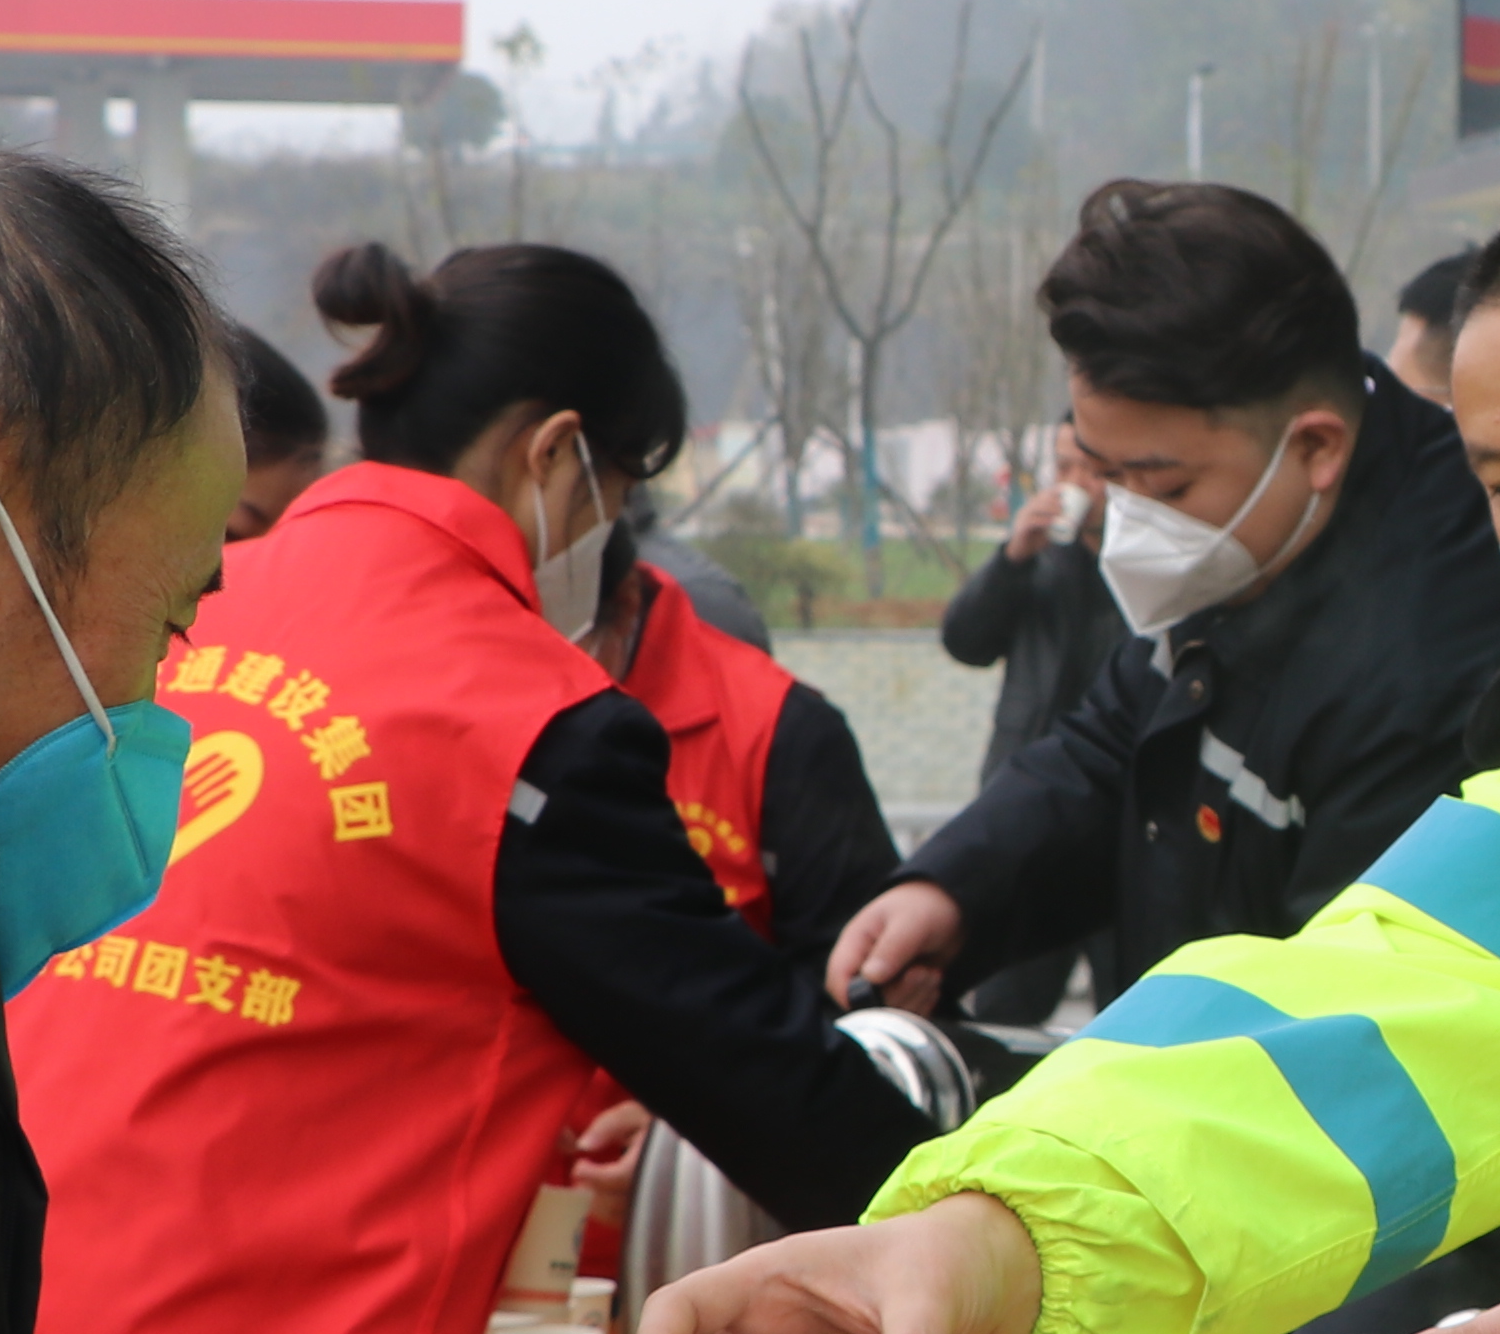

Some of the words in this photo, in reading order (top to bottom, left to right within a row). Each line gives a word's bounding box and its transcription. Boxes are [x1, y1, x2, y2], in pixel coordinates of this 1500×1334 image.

[157, 645, 393, 843] 通建设集团
